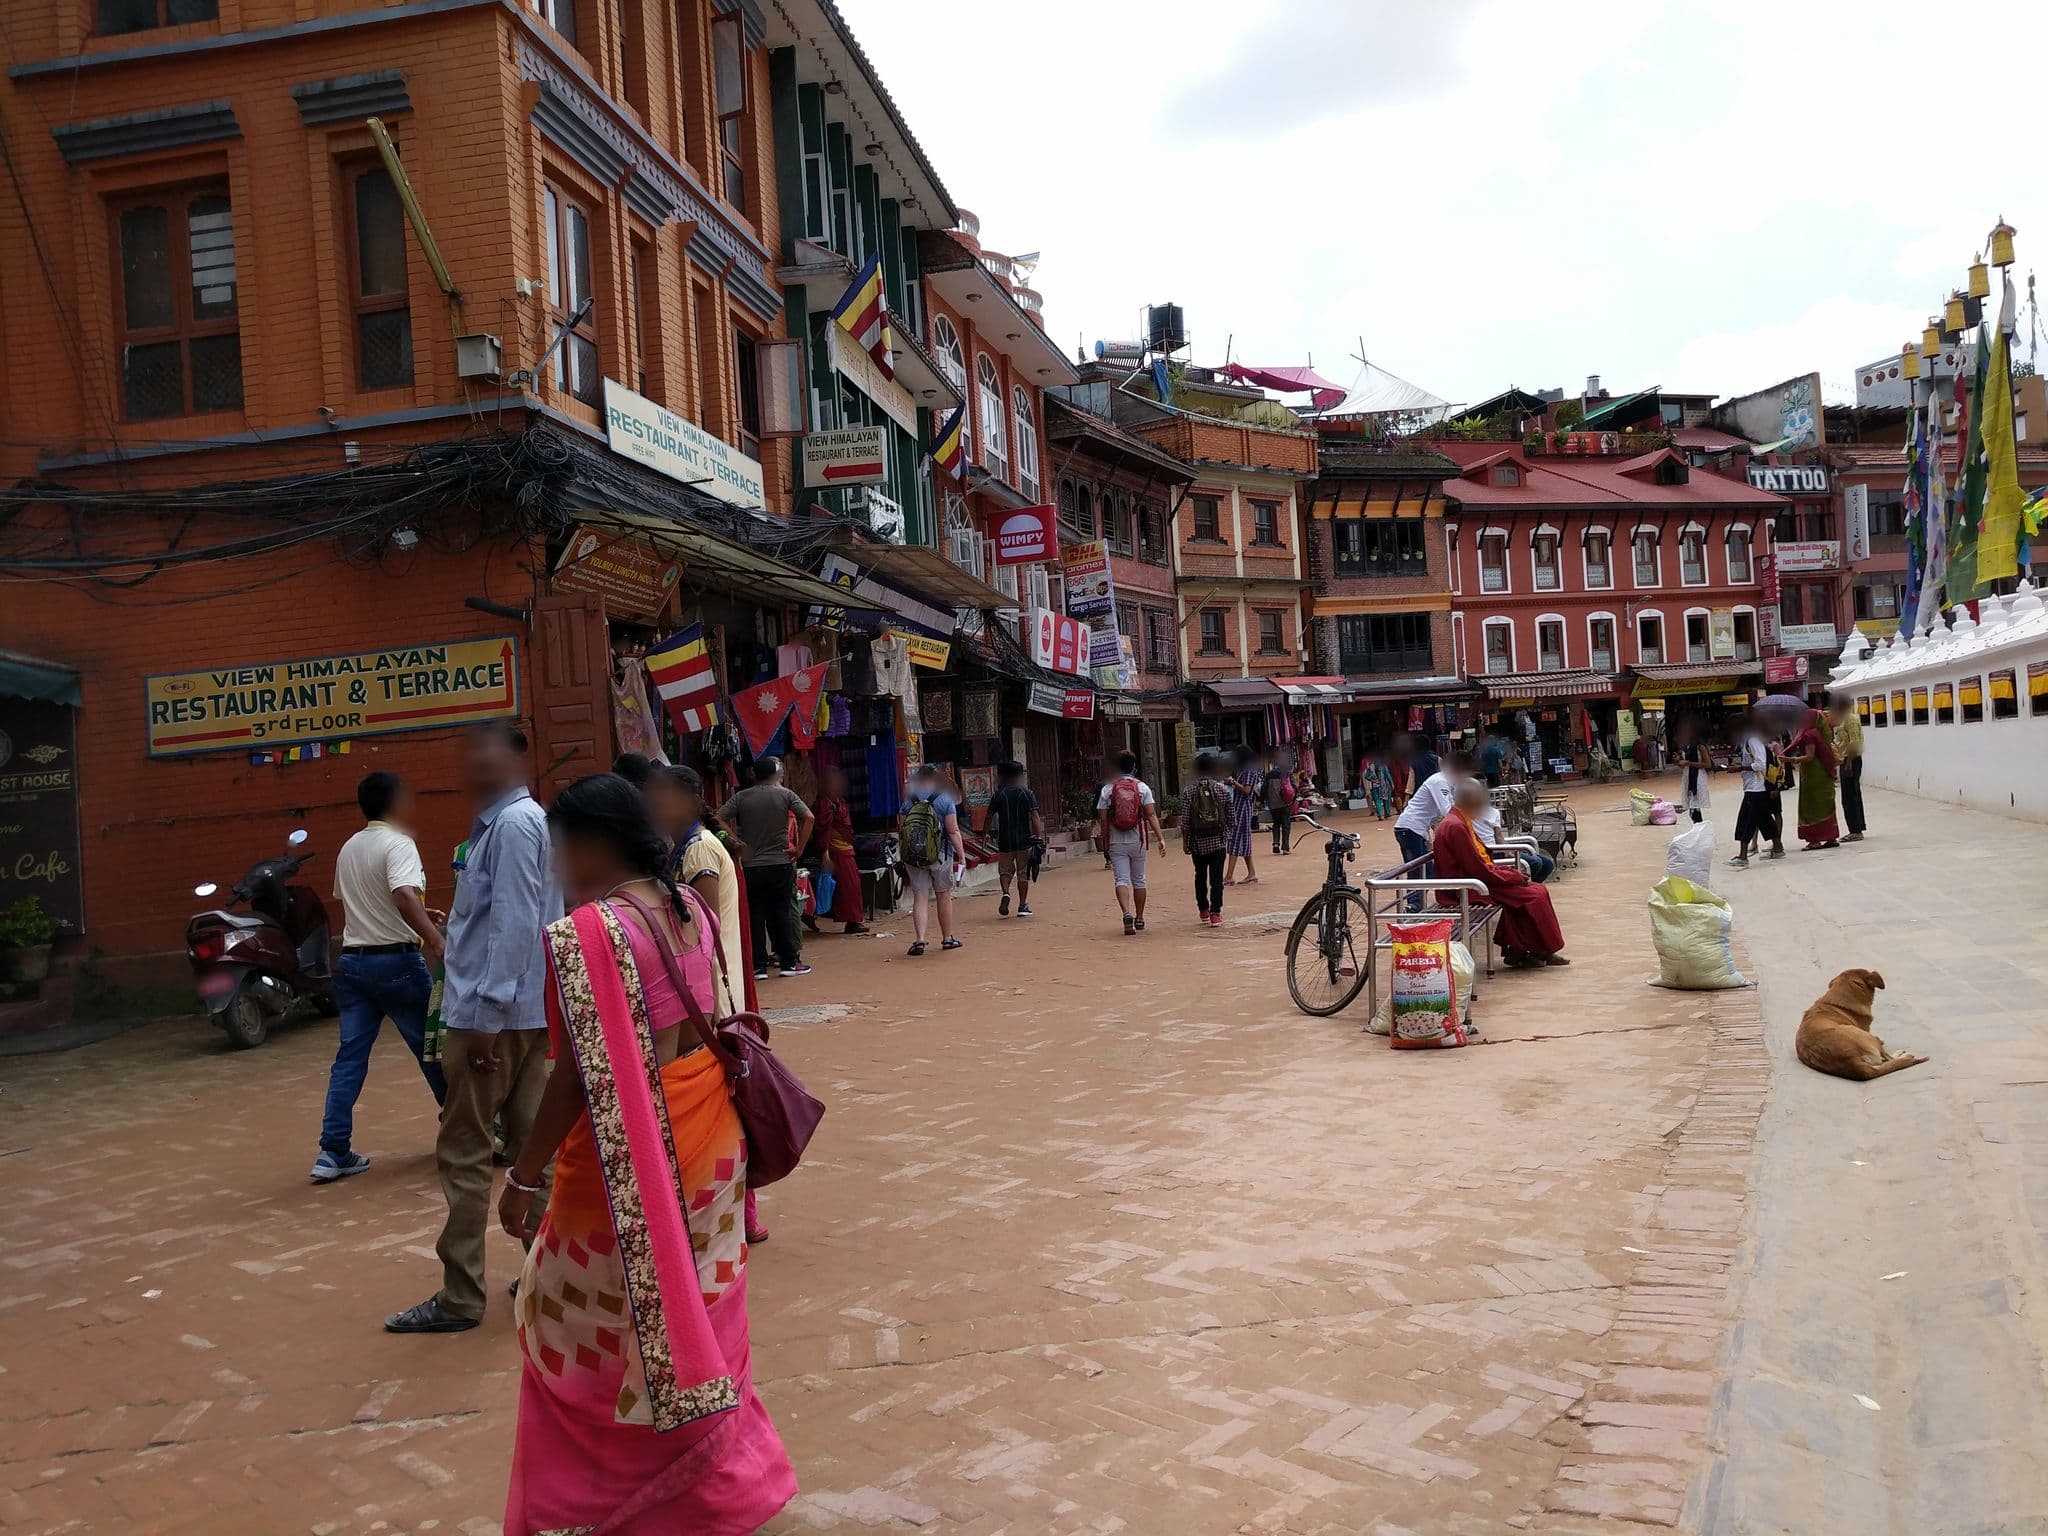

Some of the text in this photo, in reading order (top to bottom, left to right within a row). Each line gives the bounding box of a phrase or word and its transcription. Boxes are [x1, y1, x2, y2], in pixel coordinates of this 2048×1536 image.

[657, 410, 728, 462] VIEW HIMALAYAN
[807, 431, 879, 447] VIEW HIMALAYAN
[609, 407, 761, 499] RESTAURANT & TERRACE
[807, 446, 879, 462] RESTAURANT & TERRACE
[1750, 470, 1826, 491] TATTOO
[1000, 532, 1043, 546] WIMPY
[1068, 544, 1098, 561] DHL
[1066, 560, 1104, 574] aramex
[1069, 588, 1096, 599] FedEx
[1070, 603, 1089, 613] Cargo
[1809, 625, 1833, 634] GALLERY
[1091, 635, 1117, 645] CKETING
[211, 647, 446, 688] VIEW HIMALAYAN
[151, 662, 504, 725] RESTAURANT & TERRACE
[252, 713, 362, 738] 3rd FLOOR
[23, 772, 71, 788] HOUSE
[15, 851, 70, 882] Cafe
